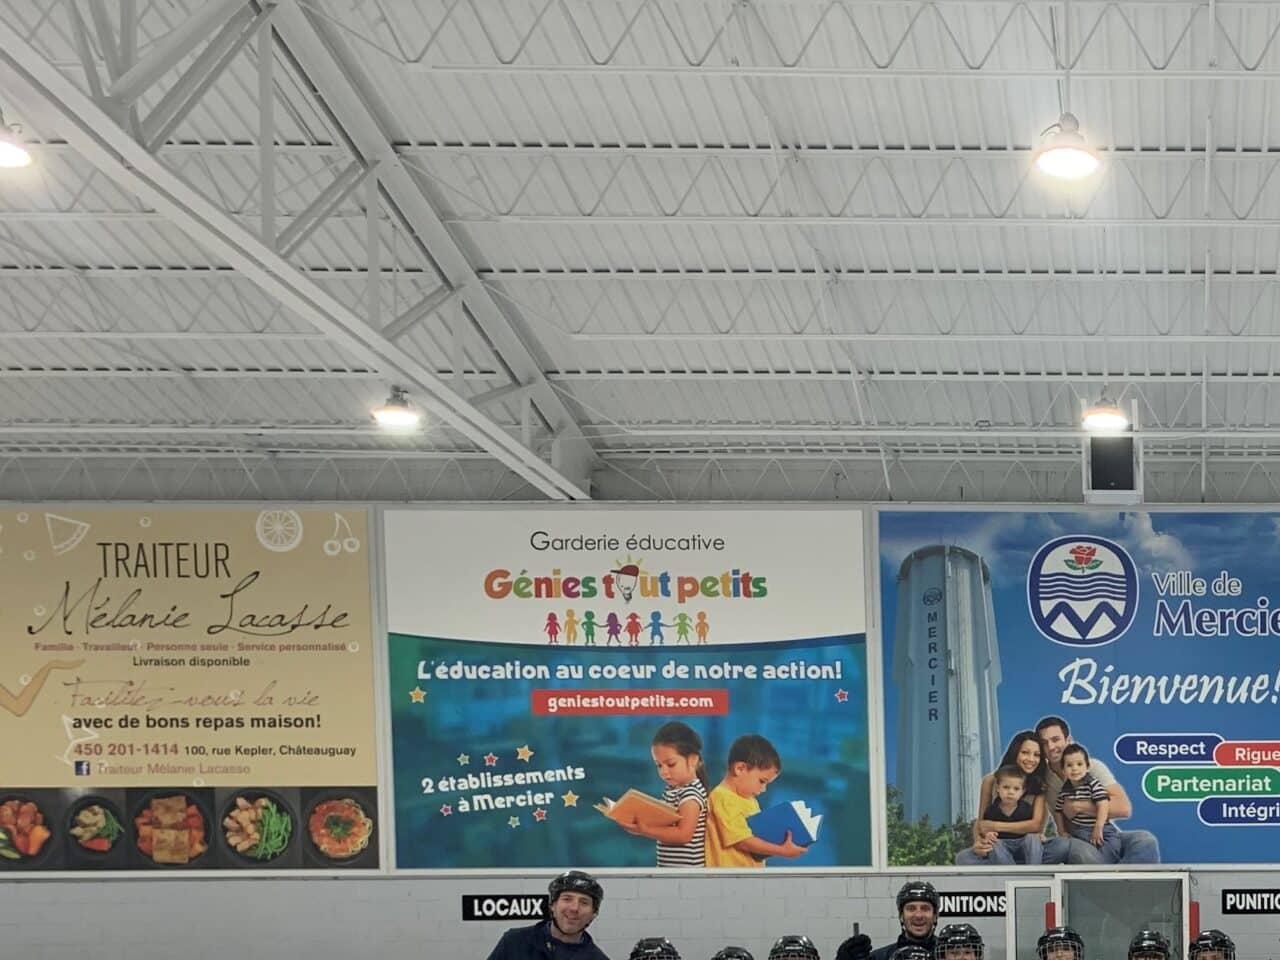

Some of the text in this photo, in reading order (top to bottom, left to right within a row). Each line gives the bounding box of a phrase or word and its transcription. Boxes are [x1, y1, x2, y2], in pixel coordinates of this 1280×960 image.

[530, 530, 725, 551] Garderie éducative
[97, 542, 231, 578] TRAITEUR
[484, 568, 597, 600] Génies
[677, 568, 767, 603] petits
[1152, 571, 1242, 596] Ville de
[27, 571, 350, 636] Mélanie Lacasse
[132, 656, 250, 669] Livraison disponible
[417, 660, 843, 680] L'éducation au coeur de notre action!
[926, 611, 940, 723] MERCIER
[547, 694, 714, 712] geniestoutpetits.com
[72, 714, 321, 731] avec de bons repas maison!
[74, 743, 357, 757] 450 201-1414 100, rue Kepler, Châteauguay
[1135, 740, 1206, 759] Respect
[421, 764, 586, 794] 2 établissements
[1156, 775, 1272, 792] Partenariat
[458, 789, 555, 812] à Mercier
[474, 898, 543, 917] LOCAUX
